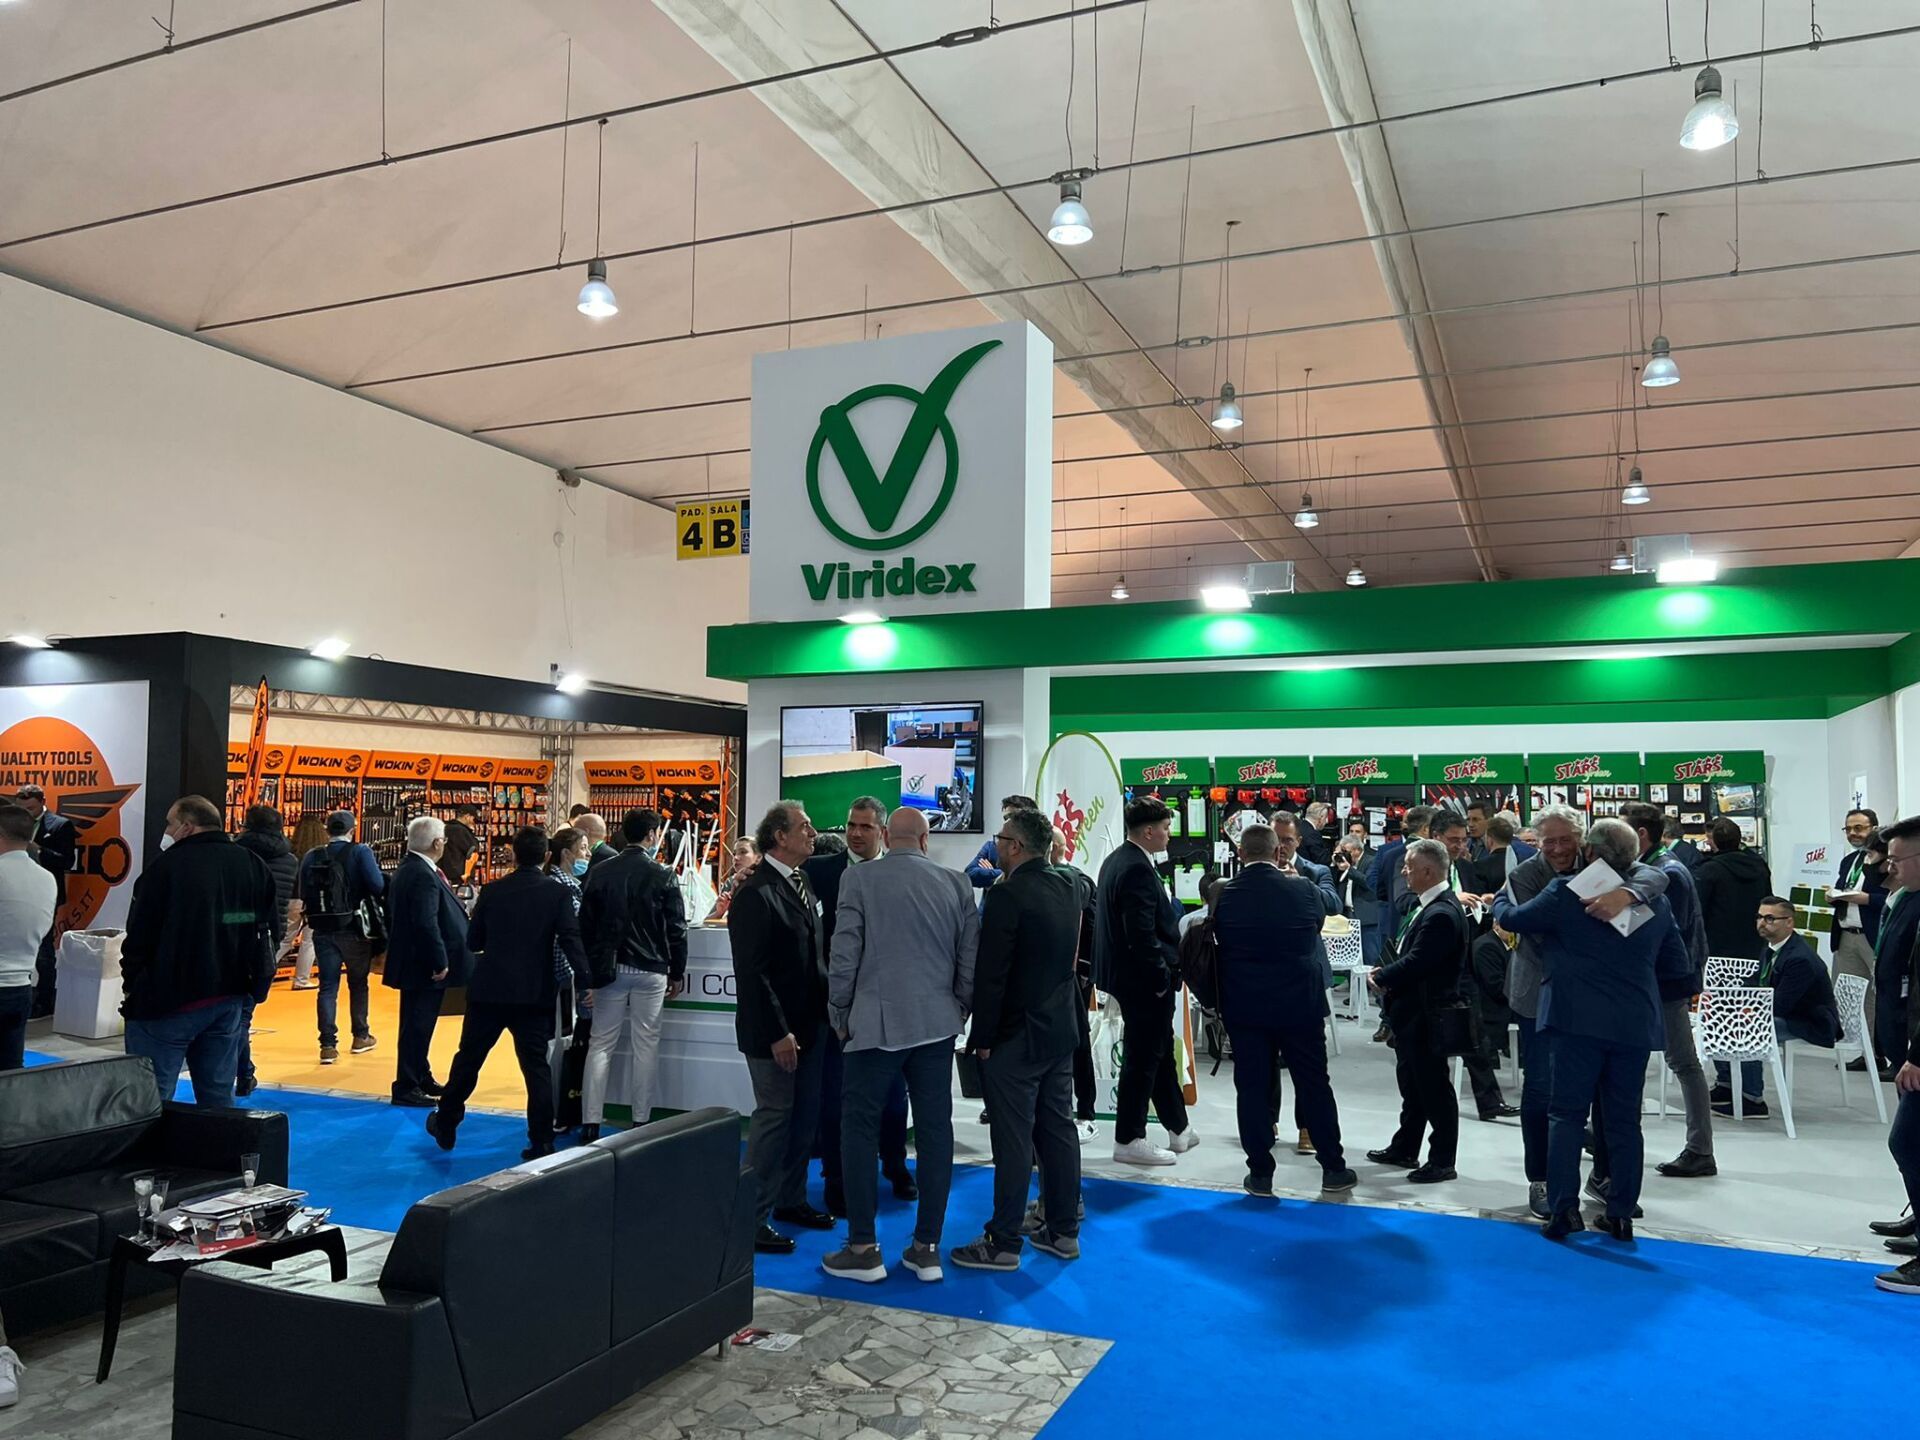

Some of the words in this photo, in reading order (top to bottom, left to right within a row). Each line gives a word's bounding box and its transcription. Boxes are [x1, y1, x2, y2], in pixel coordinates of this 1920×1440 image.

[680, 508, 705, 518] PAD.
[710, 504, 737, 515] SALA
[682, 521, 703, 551] 4
[713, 518, 736, 549] B
[801, 557, 977, 600] Viridex
[50, 751, 92, 765] TOOLS
[297, 755, 343, 768] WOKIN
[374, 759, 414, 771] WOKIN
[442, 763, 478, 774] WOKIN
[502, 766, 535, 777] WOKIN
[589, 768, 628, 778] WOKIN
[655, 768, 697, 777] WOKIN
[1142, 763, 1177, 782] STARS
[1238, 762, 1277, 782] STARS
[1338, 760, 1378, 782] STARS
[1444, 759, 1487, 781] STARS
[1555, 758, 1600, 781] STARS
[1674, 757, 1723, 781] STARS
[52, 770, 98, 786] WORK
